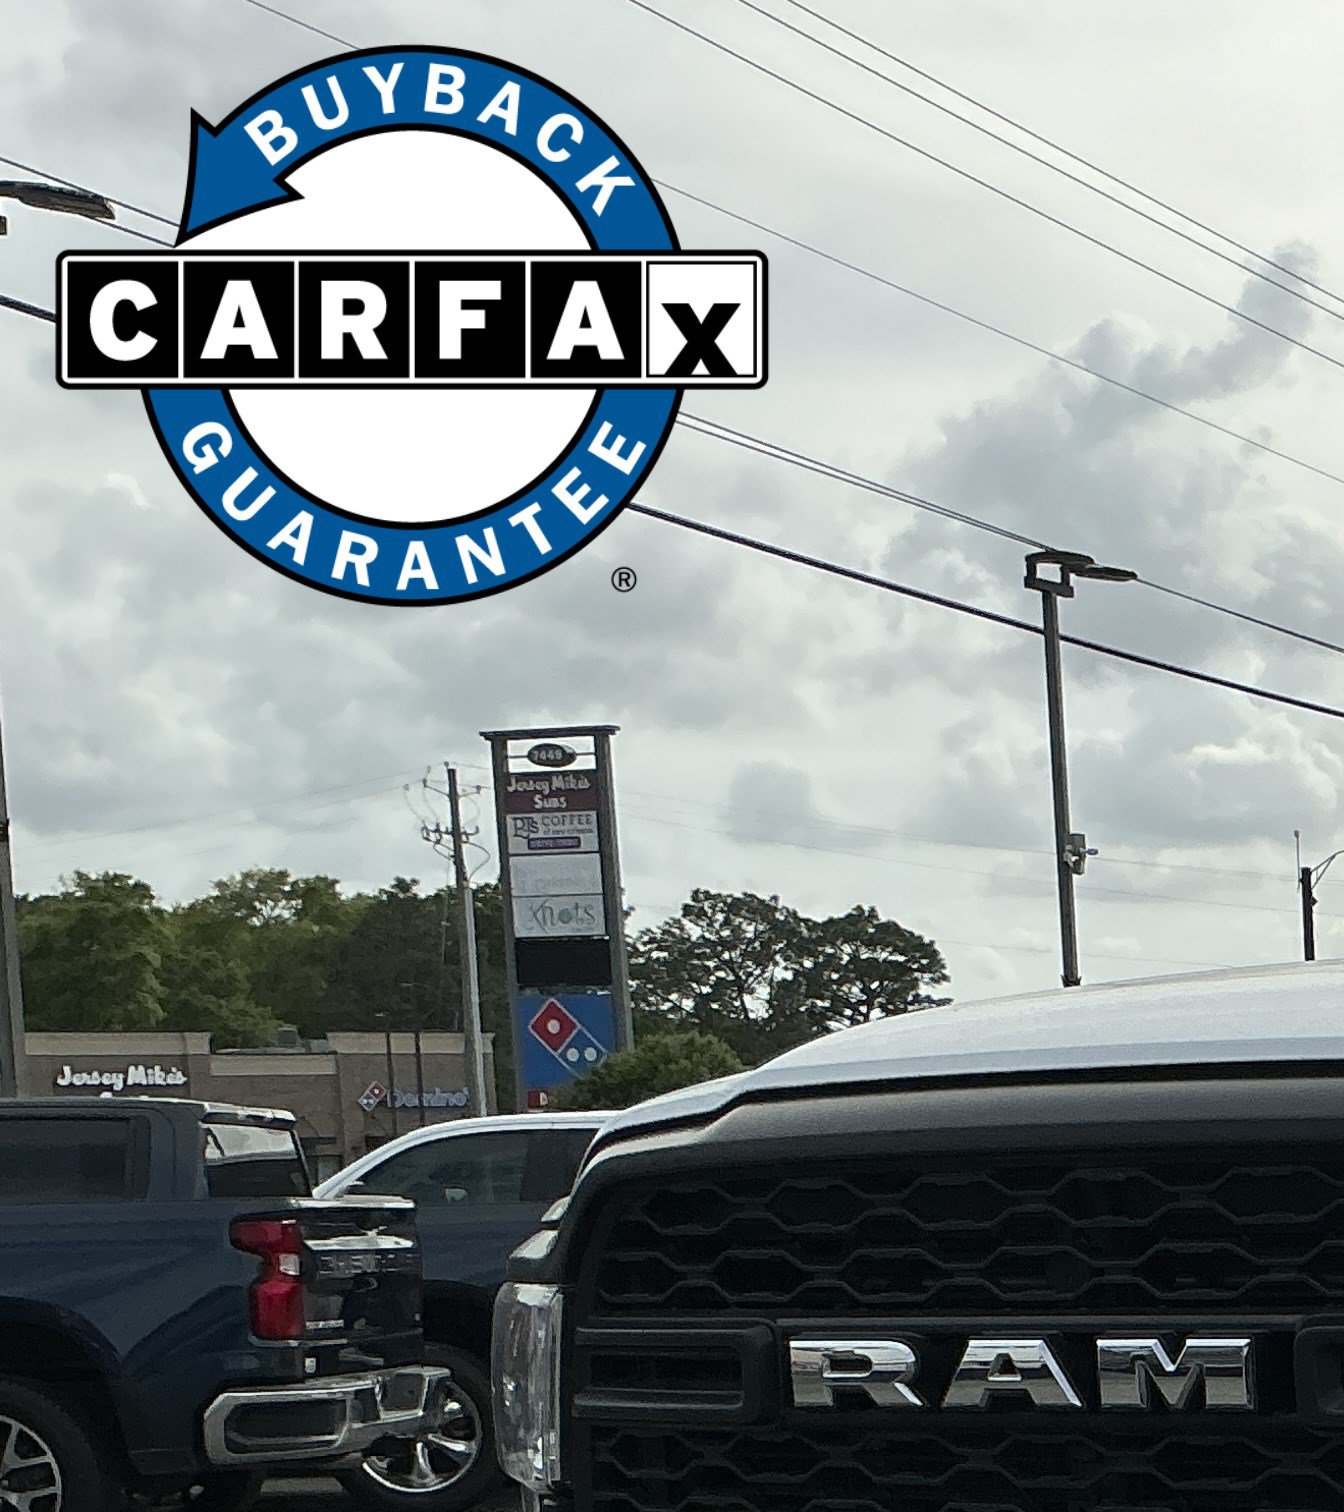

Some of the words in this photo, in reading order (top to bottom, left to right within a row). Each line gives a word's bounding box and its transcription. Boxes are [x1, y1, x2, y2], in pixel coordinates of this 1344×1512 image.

[541, 814, 593, 827] COFFEE
[57, 1065, 125, 1092] Jersey
[126, 1065, 188, 1086] Mike's
[788, 1338, 1256, 1410] RAM
